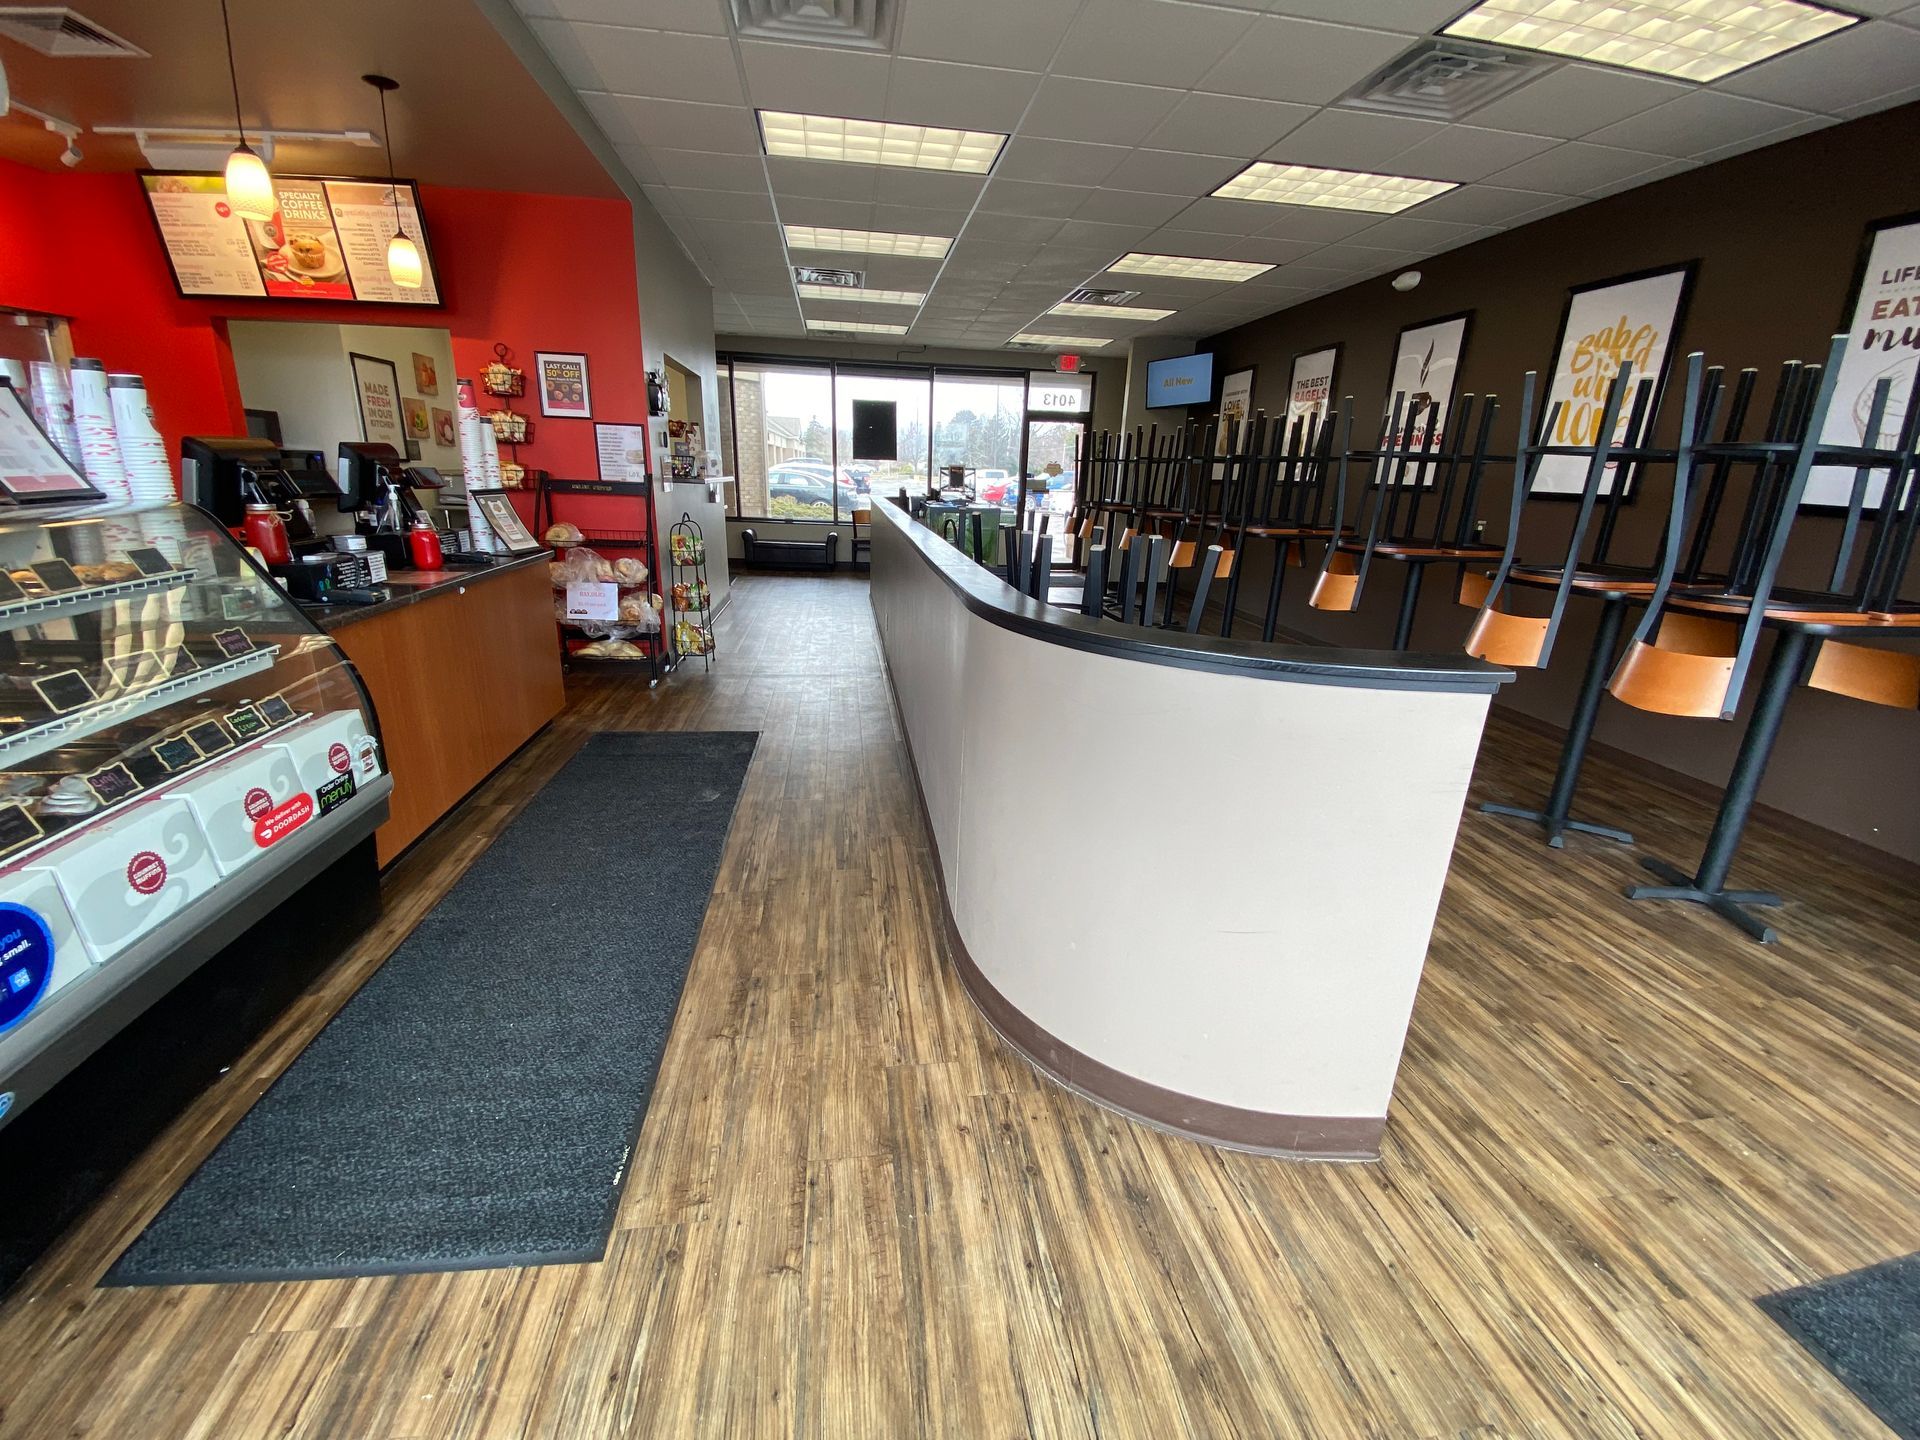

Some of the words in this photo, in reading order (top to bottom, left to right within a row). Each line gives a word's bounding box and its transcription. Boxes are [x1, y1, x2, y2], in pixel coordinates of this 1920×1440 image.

[279, 192, 320, 200] SPECIALTY
[281, 199, 324, 210] COFFEE
[284, 209, 327, 220] DRINKS
[1570, 315, 1659, 374] Baked
[563, 370, 580, 378] OFF
[364, 382, 389, 396] MADE
[1163, 379, 1174, 388] All
[1175, 377, 1194, 386] New
[1297, 380, 1310, 389] THE
[1310, 376, 1329, 387] BEST
[367, 395, 391, 408] FRESH
[1295, 388, 1328, 402] BAGELS
[369, 407, 378, 418] IN
[378, 410, 393, 420] OUR
[370, 419, 395, 429] KITCHEN
[321, 783, 335, 794] Order
[334, 773, 349, 785] Online
[321, 778, 353, 809] menufy
[248, 796, 268, 810] GOURMET
[250, 801, 270, 815] MUFFINS
[264, 818, 275, 827] We
[274, 808, 291, 821] deliver
[291, 801, 302, 811] with
[273, 805, 310, 833] DOORDASH
[133, 860, 160, 880] GOURMET
[135, 866, 162, 885] MUFFINS
[0, 929, 21, 951] you
[3, 939, 31, 961] small.
